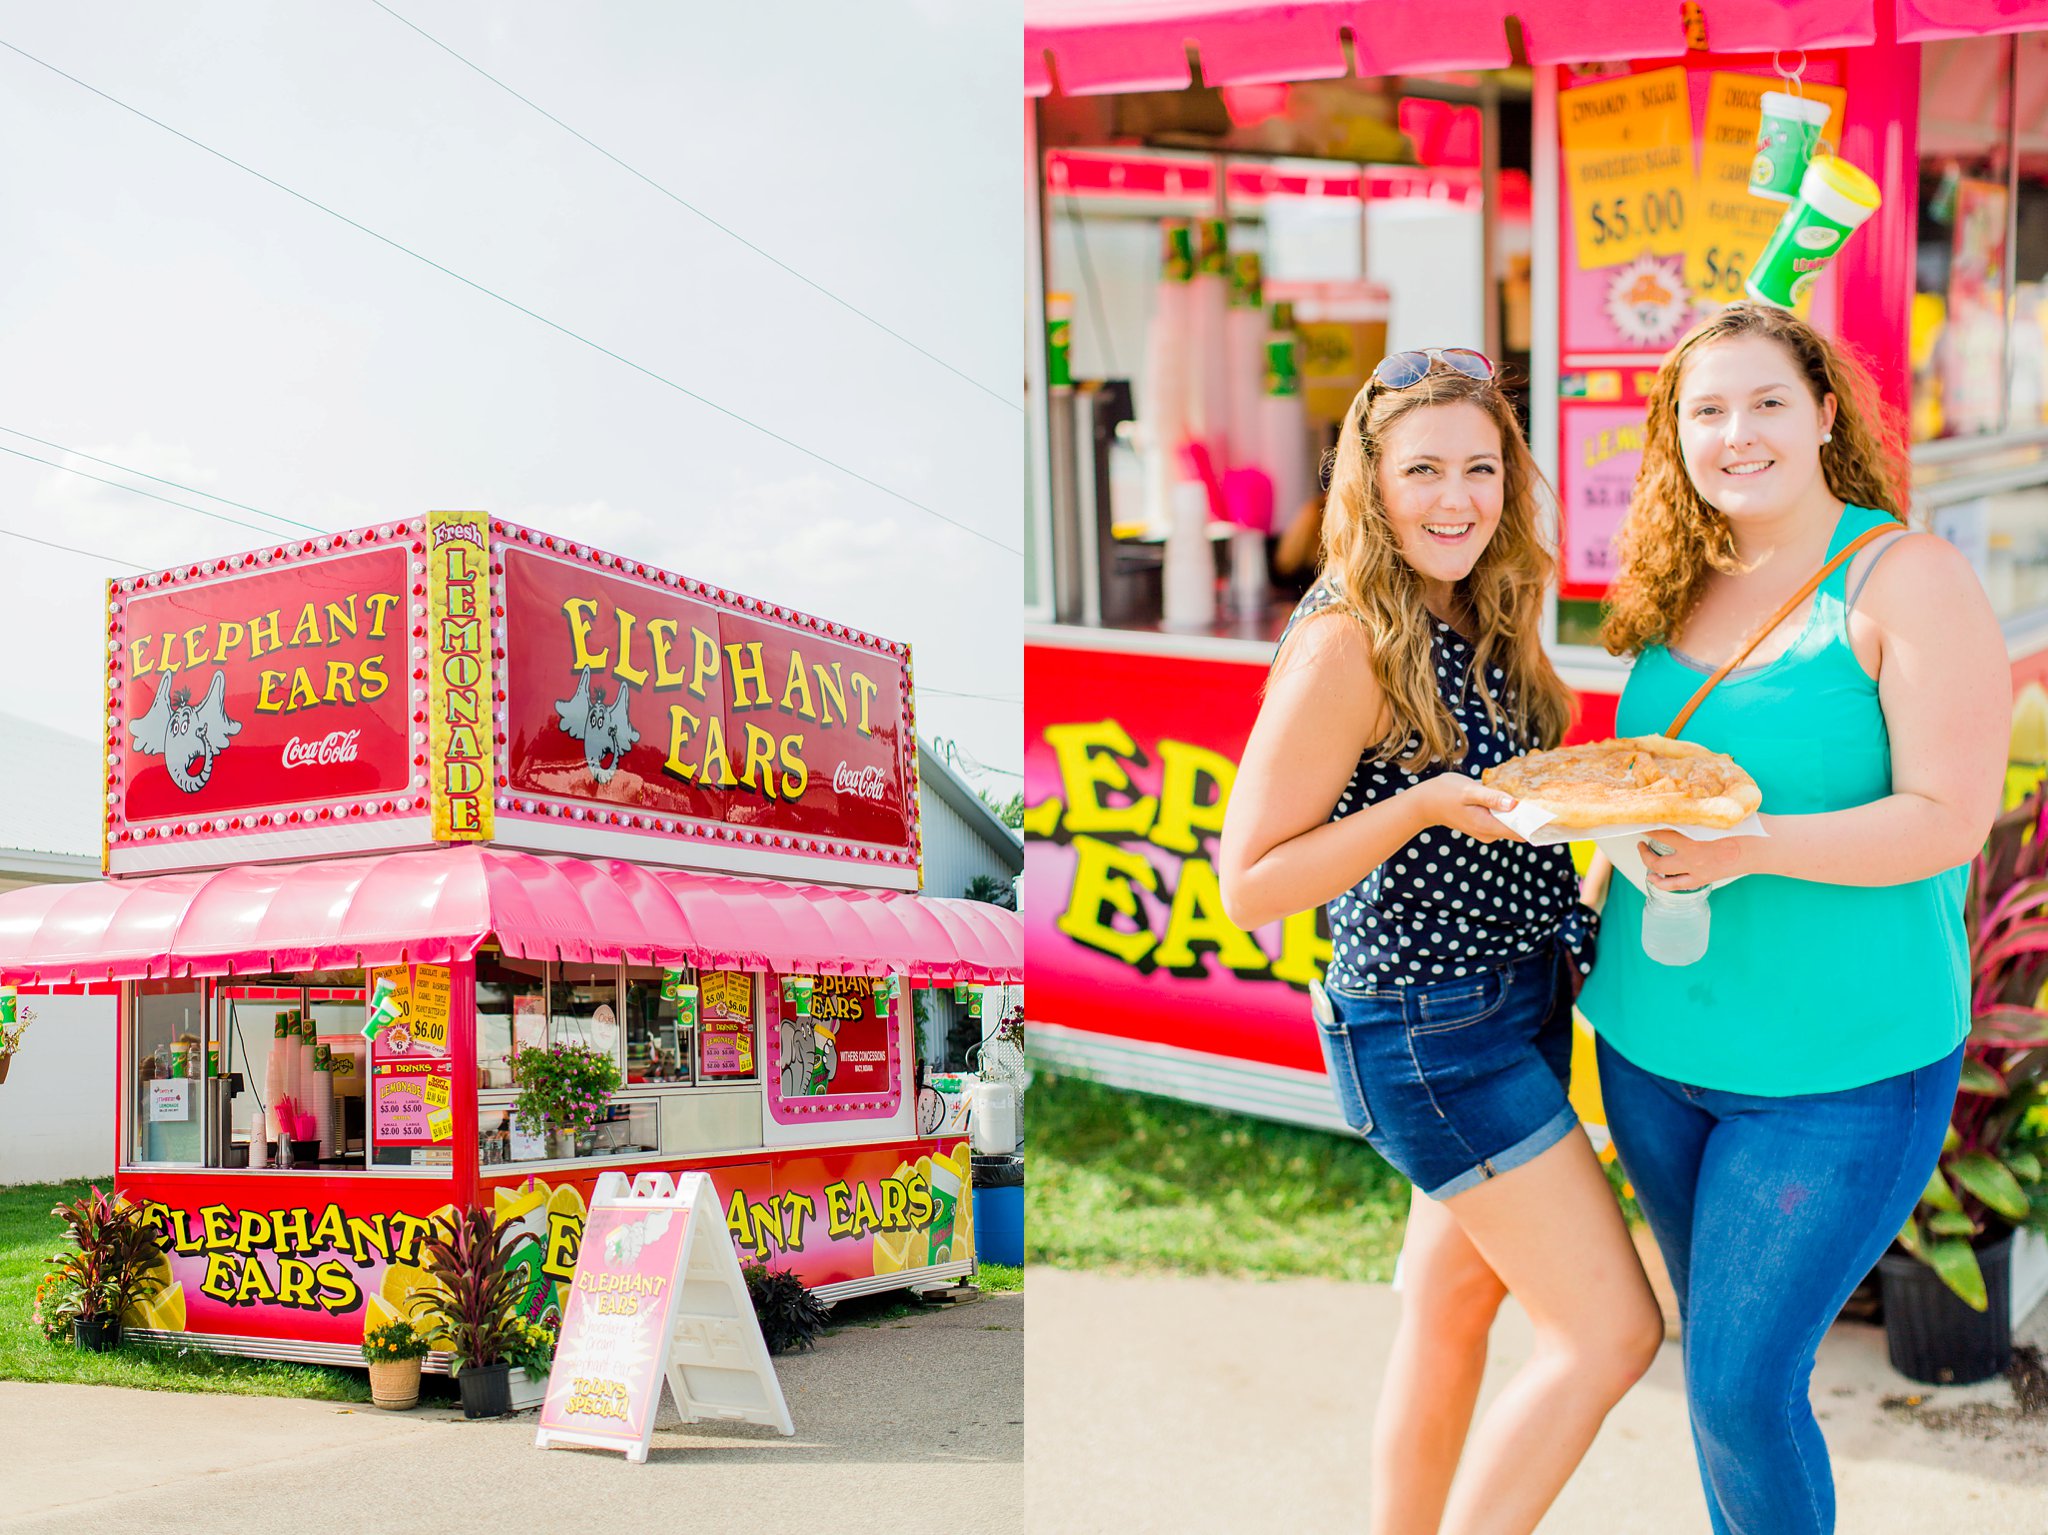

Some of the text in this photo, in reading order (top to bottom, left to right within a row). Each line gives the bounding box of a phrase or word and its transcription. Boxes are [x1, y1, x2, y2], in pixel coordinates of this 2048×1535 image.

[1590, 187, 1686, 245] $5.00
[432, 522, 485, 550] Fresh
[129, 593, 400, 679] ELEPHANT
[562, 597, 878, 736] ELEPHANT
[254, 654, 390, 714] EARS
[441, 549, 483, 831] LEMONADE
[282, 729, 361, 768] Coca-Cola
[663, 704, 809, 804] EARS
[832, 760, 887, 801] Coca-Cola
[706, 991, 725, 1005] $5.00
[728, 1000, 747, 1014] $6.00
[811, 994, 864, 1020] EARS
[413, 1019, 444, 1041] $6.00
[395, 1063, 433, 1073] DRINKS
[840, 1050, 886, 1062] WITHERS CONCESSIONS
[380, 1080, 423, 1099] LEMONADE
[431, 1077, 447, 1086] SOFT
[402, 1104, 422, 1113] $5.00
[381, 1127, 400, 1136] $2.00
[824, 1172, 938, 1242] EARS
[141, 1199, 437, 1267] ELEPHANT
[201, 1252, 364, 1316] EARS
[577, 1270, 667, 1297] ELEPHANT
[597, 1293, 639, 1316] EARS
[565, 1394, 630, 1422] SPECIAL!
